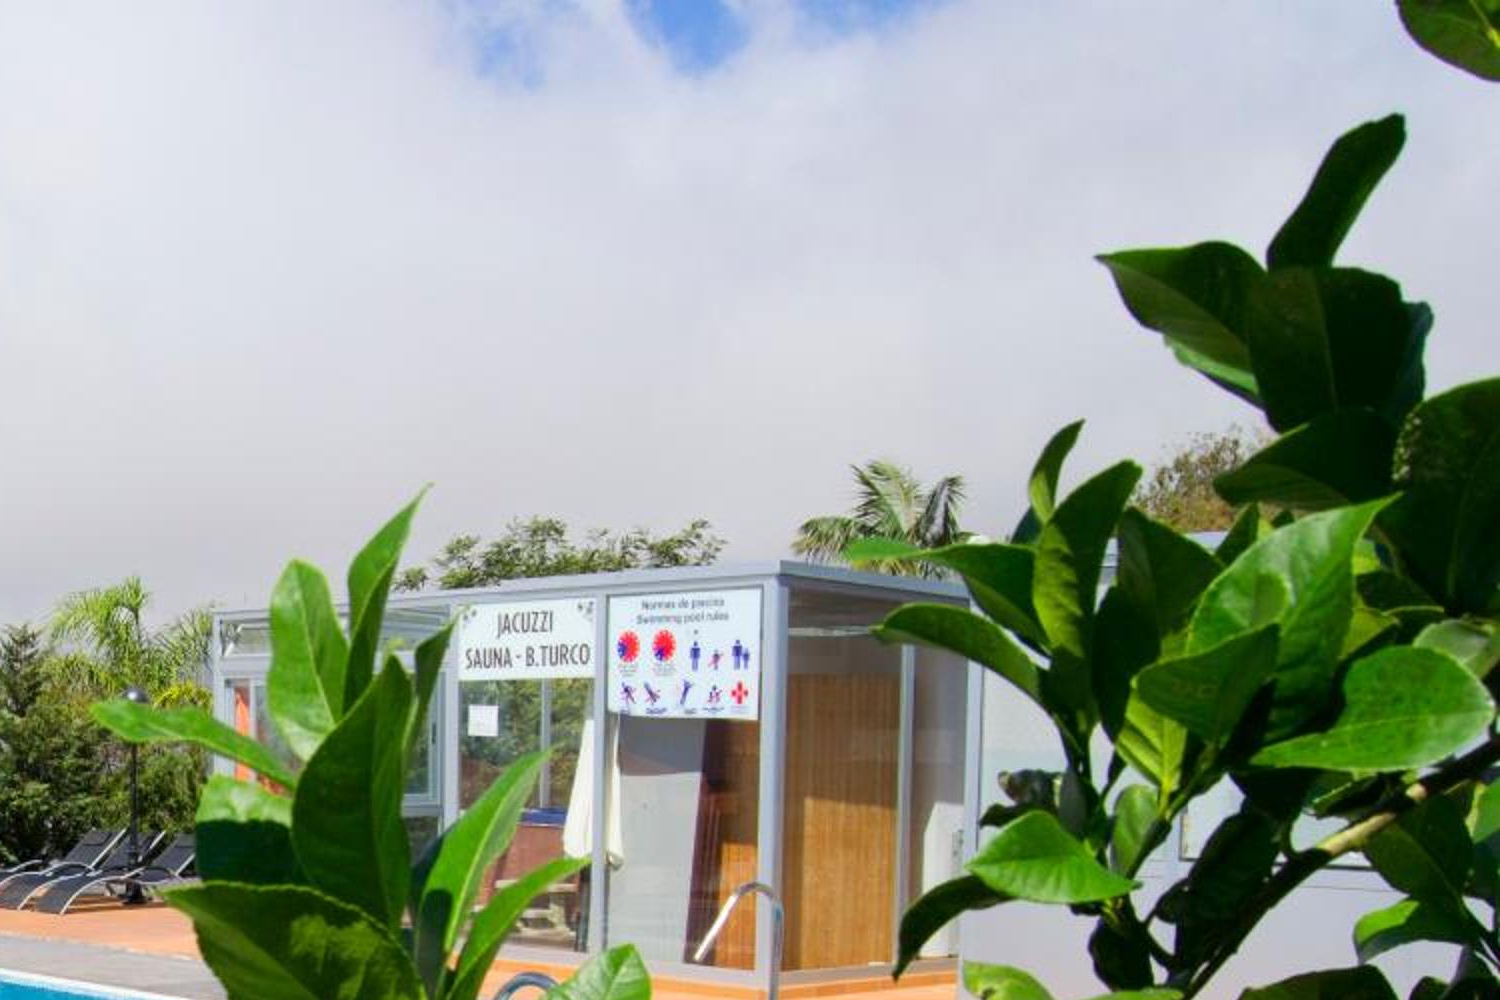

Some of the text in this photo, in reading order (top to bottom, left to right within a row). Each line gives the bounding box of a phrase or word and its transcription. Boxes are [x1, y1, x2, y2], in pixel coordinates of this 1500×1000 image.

[497, 610, 554, 639] JACUZZI
[465, 646, 513, 669] SAUNA
[525, 643, 591, 667] B.TURCO
